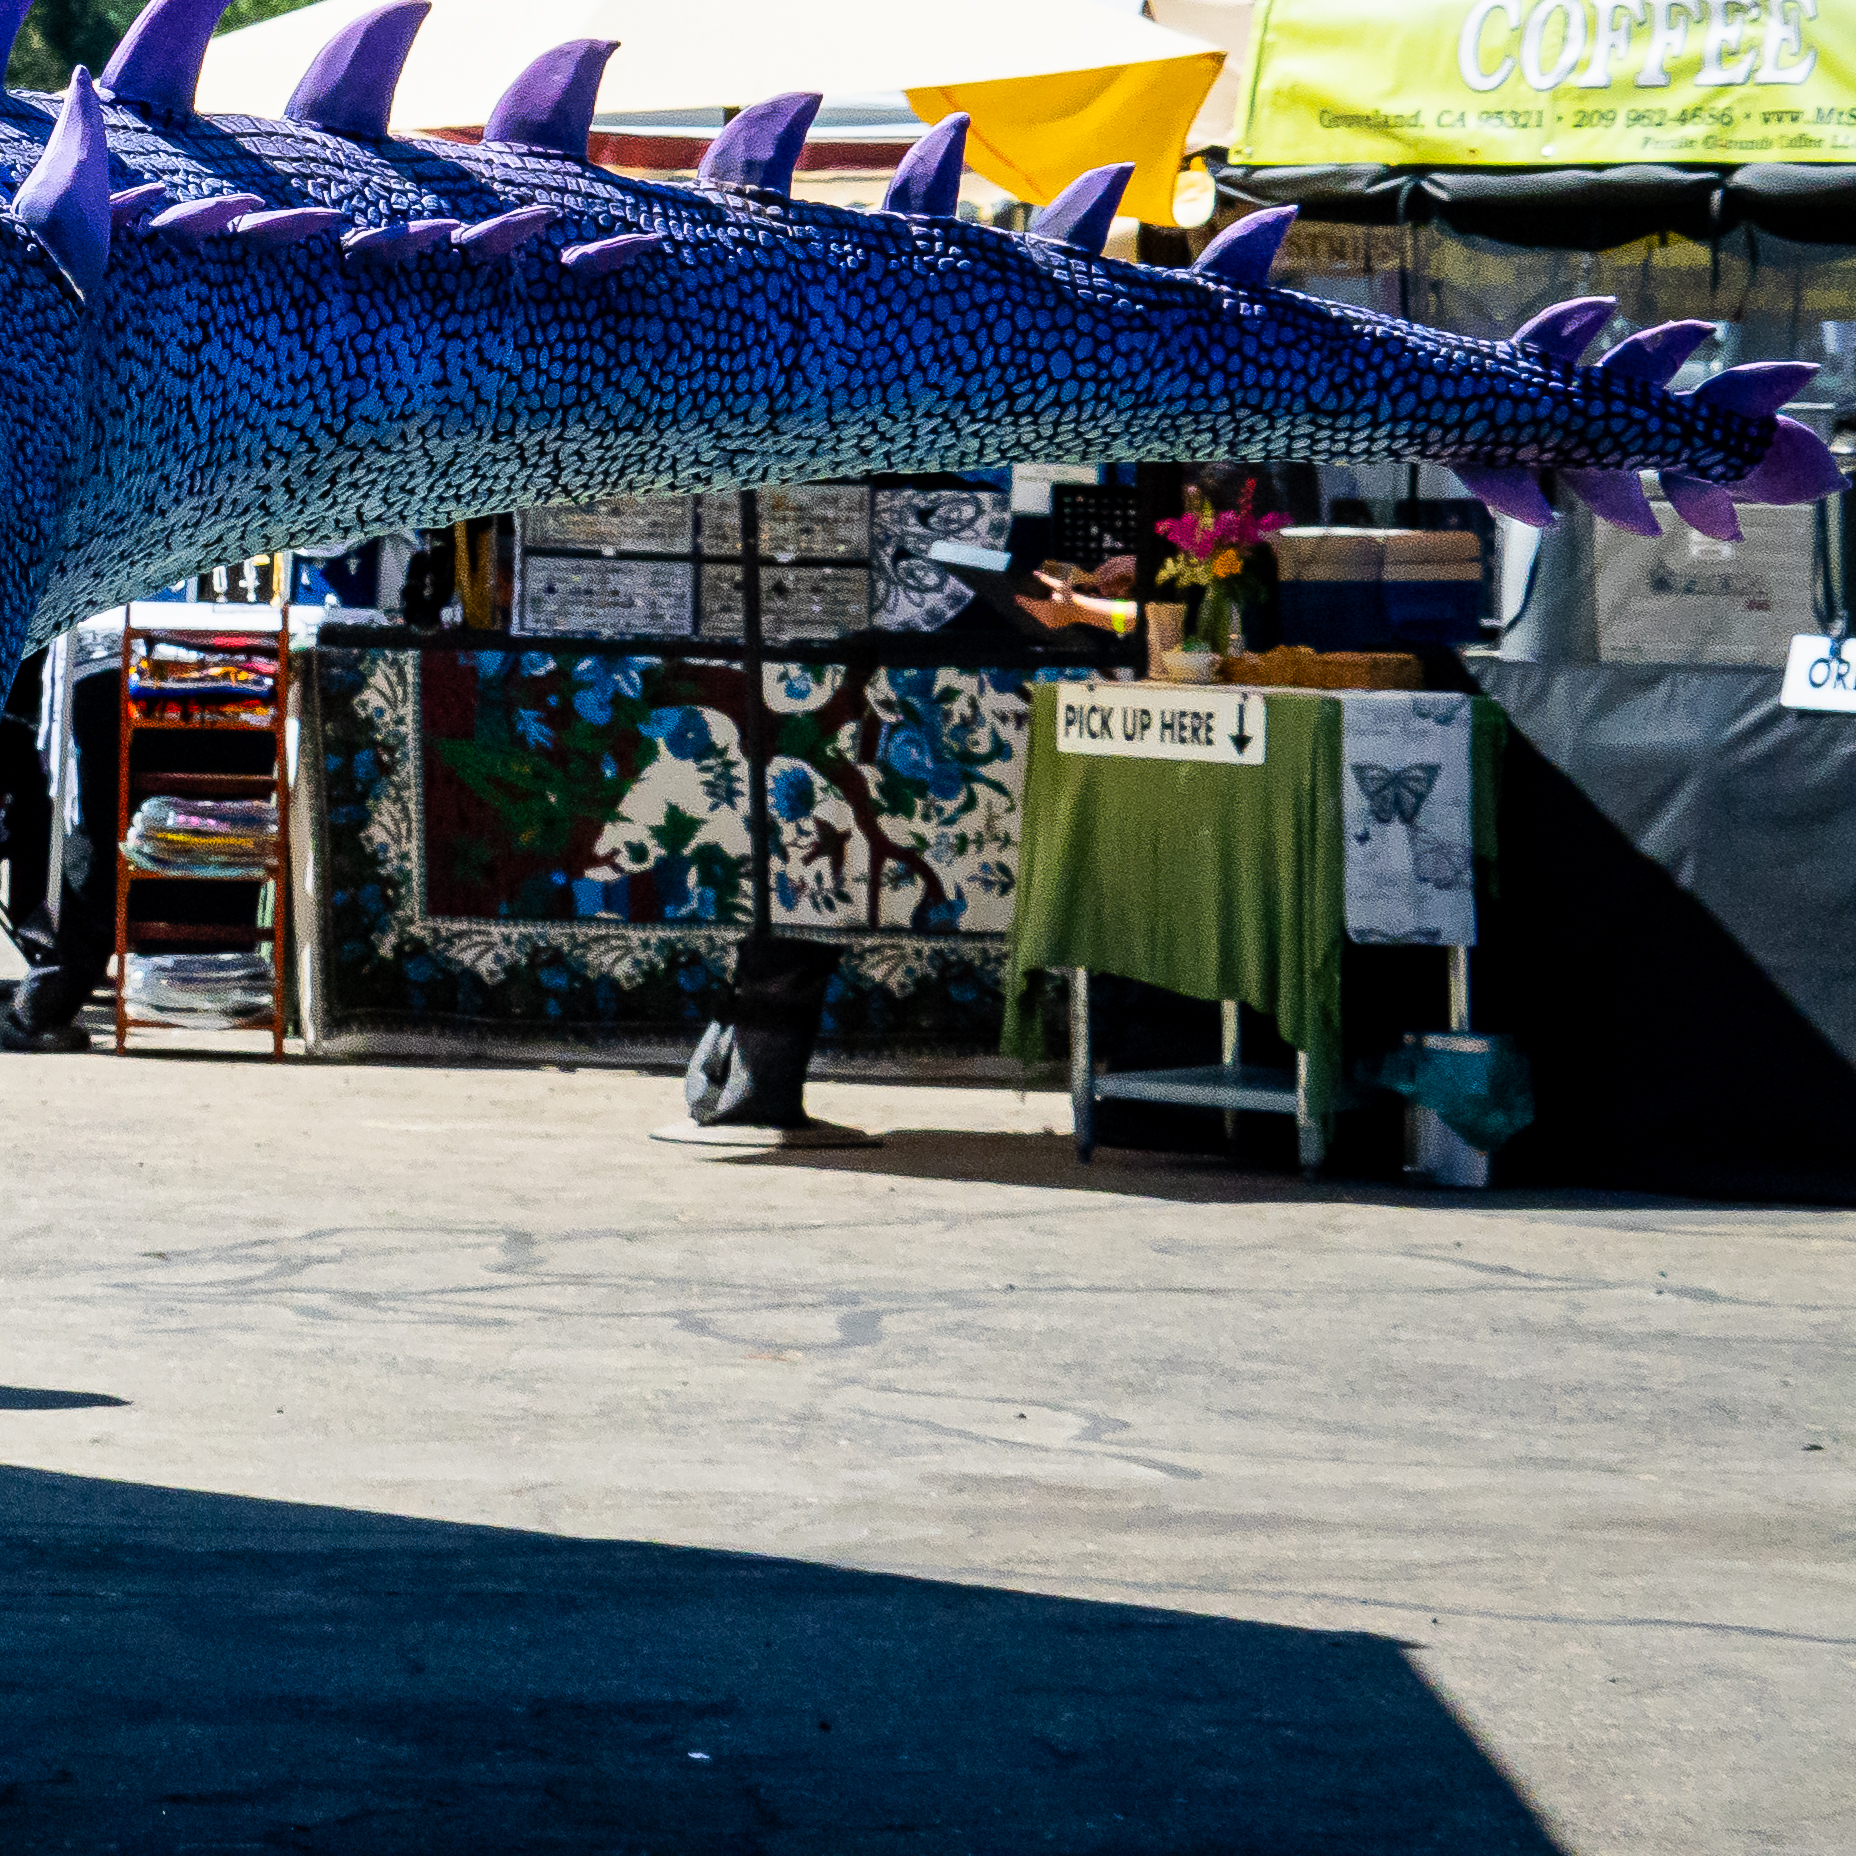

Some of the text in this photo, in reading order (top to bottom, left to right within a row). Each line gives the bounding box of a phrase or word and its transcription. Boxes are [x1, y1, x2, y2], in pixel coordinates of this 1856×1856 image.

[1436, 109, 1467, 129] CA
[1572, 107, 1617, 129] 209
[1808, 657, 1856, 691] OR
[1065, 703, 1215, 747] PICK UP HERE
